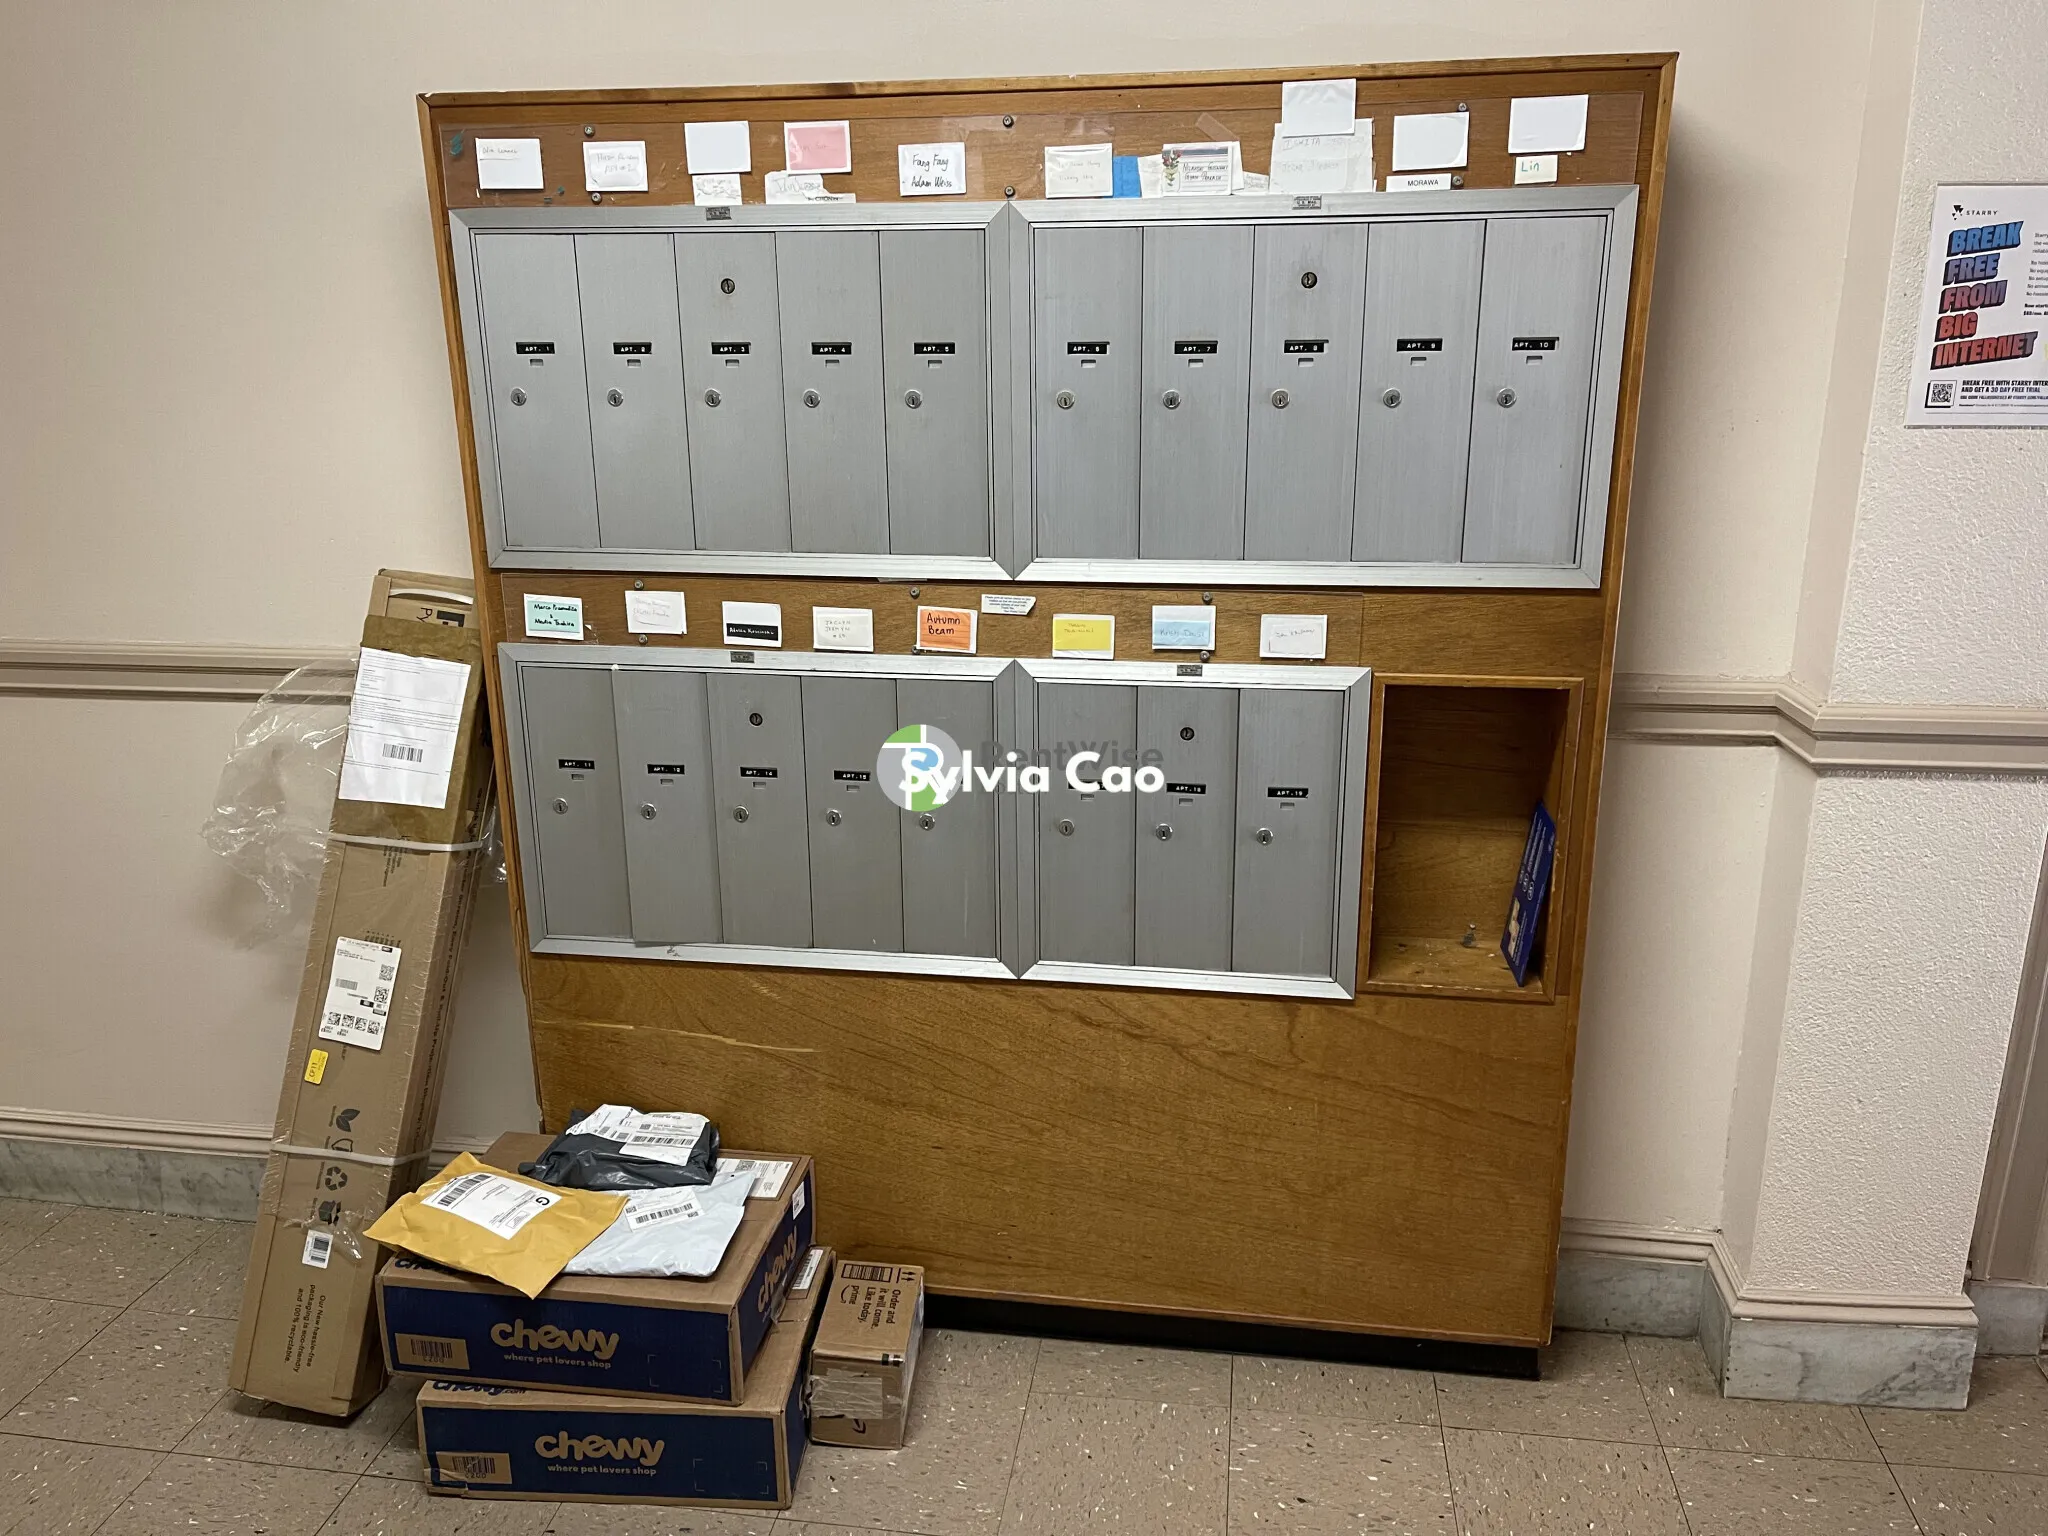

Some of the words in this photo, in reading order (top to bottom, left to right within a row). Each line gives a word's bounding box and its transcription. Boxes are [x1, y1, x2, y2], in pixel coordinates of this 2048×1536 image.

[933, 153, 949, 172] Fang
[1520, 161, 1540, 172] Lin
[911, 175, 932, 188] Adam
[934, 174, 953, 188] Weiss
[1407, 179, 1440, 187] MORAWA
[1947, 221, 2024, 257] BREAK
[1943, 253, 2000, 286] FREE
[1938, 280, 2008, 314] FROM
[1934, 312, 1978, 342] BIG
[1930, 331, 2038, 370] INTERNET
[926, 610, 961, 624] Autumn
[928, 624, 955, 636] Beam
[535, 1196, 550, 1206] G
[303, 1284, 316, 1321] packaging
[318, 1295, 326, 1308] Our
[849, 1284, 860, 1304] prime
[864, 1286, 876, 1301] Like
[876, 1295, 886, 1308] will
[890, 1289, 901, 1310] Order
[292, 1304, 302, 1323] 100%
[316, 1310, 324, 1326] New
[886, 1310, 896, 1324] and
[306, 1326, 320, 1367] hassle-free
[490, 1318, 620, 1360] chewy
[293, 1330, 306, 1374] eco-friendly
[504, 1352, 534, 1362] where
[536, 1356, 552, 1364] pet
[554, 1356, 586, 1367] lovers
[587, 1360, 612, 1370] shop
[534, 1430, 665, 1467] chewy
[548, 1463, 578, 1472] where
[580, 1466, 598, 1474] pet
[600, 1465, 630, 1475] lovers
[632, 1466, 657, 1476] shop
